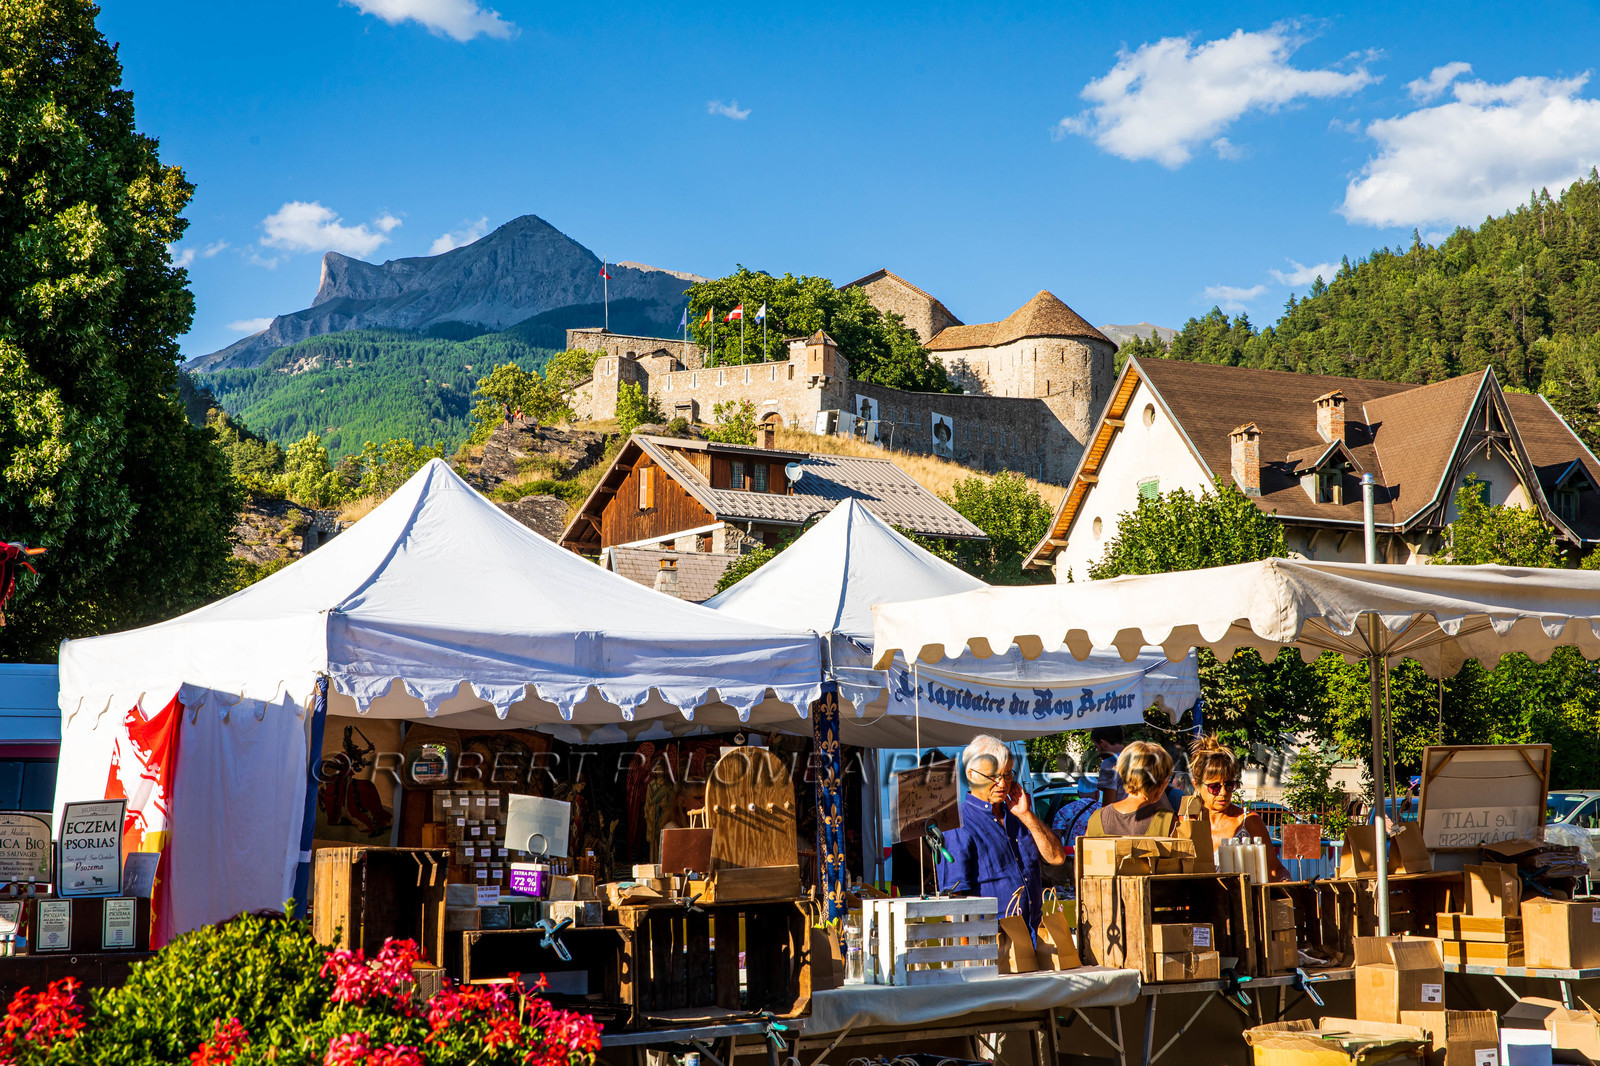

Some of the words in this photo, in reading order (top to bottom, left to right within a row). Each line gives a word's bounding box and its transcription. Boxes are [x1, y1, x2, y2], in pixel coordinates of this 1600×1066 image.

[894, 670, 924, 702] Le
[927, 681, 1006, 714] lapidaire
[1008, 691, 1029, 716] du
[1032, 687, 1074, 720] Roy
[1077, 688, 1136, 719] Arthur
[65, 820, 117, 834] ECZEM
[66, 837, 115, 849] PSORIAS
[75, 862, 104, 872] Psozema
[514, 876, 525, 886] 72
[526, 877, 536, 887] %
